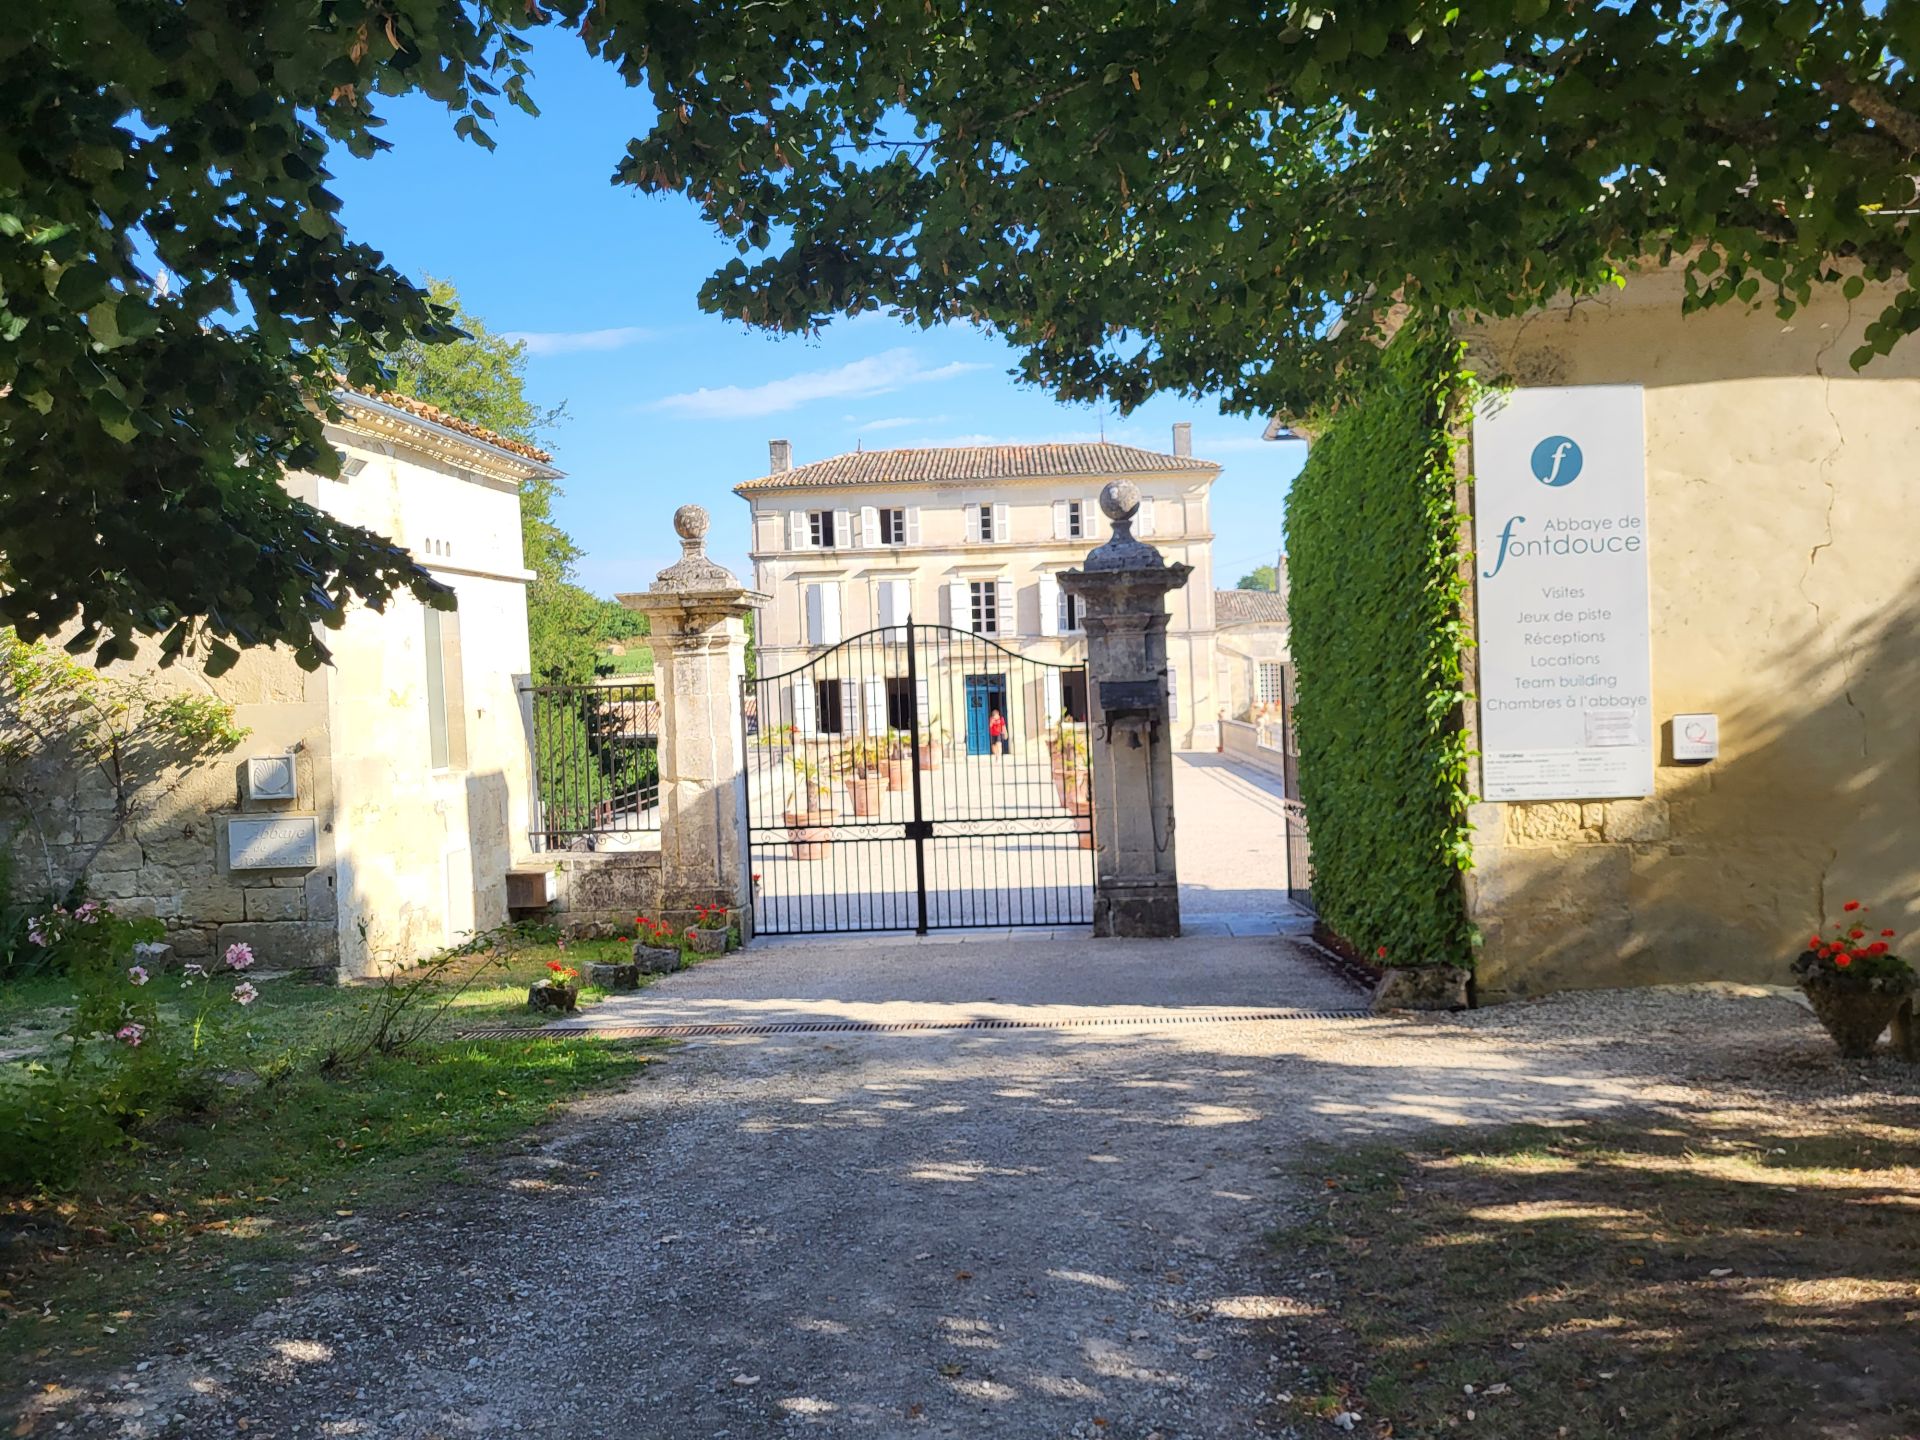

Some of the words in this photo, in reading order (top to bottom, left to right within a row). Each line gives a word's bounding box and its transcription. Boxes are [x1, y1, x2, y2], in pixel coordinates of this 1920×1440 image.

[1543, 517, 1613, 533] Abbaye
[1618, 515, 1641, 529] de
[1482, 515, 1641, 579] fontdouce
[1541, 586, 1585, 599] Visites
[1517, 611, 1550, 624] Jeux
[1554, 609, 1574, 623] de
[1578, 608, 1612, 623] piste
[1524, 631, 1606, 646] Réceptions
[1531, 653, 1601, 668] Locations
[1515, 677, 1556, 690] Team
[1560, 674, 1617, 689] building
[1486, 697, 1562, 712] Chambres
[1566, 695, 1576, 708] à
[1580, 695, 1648, 710] l'abbaye
